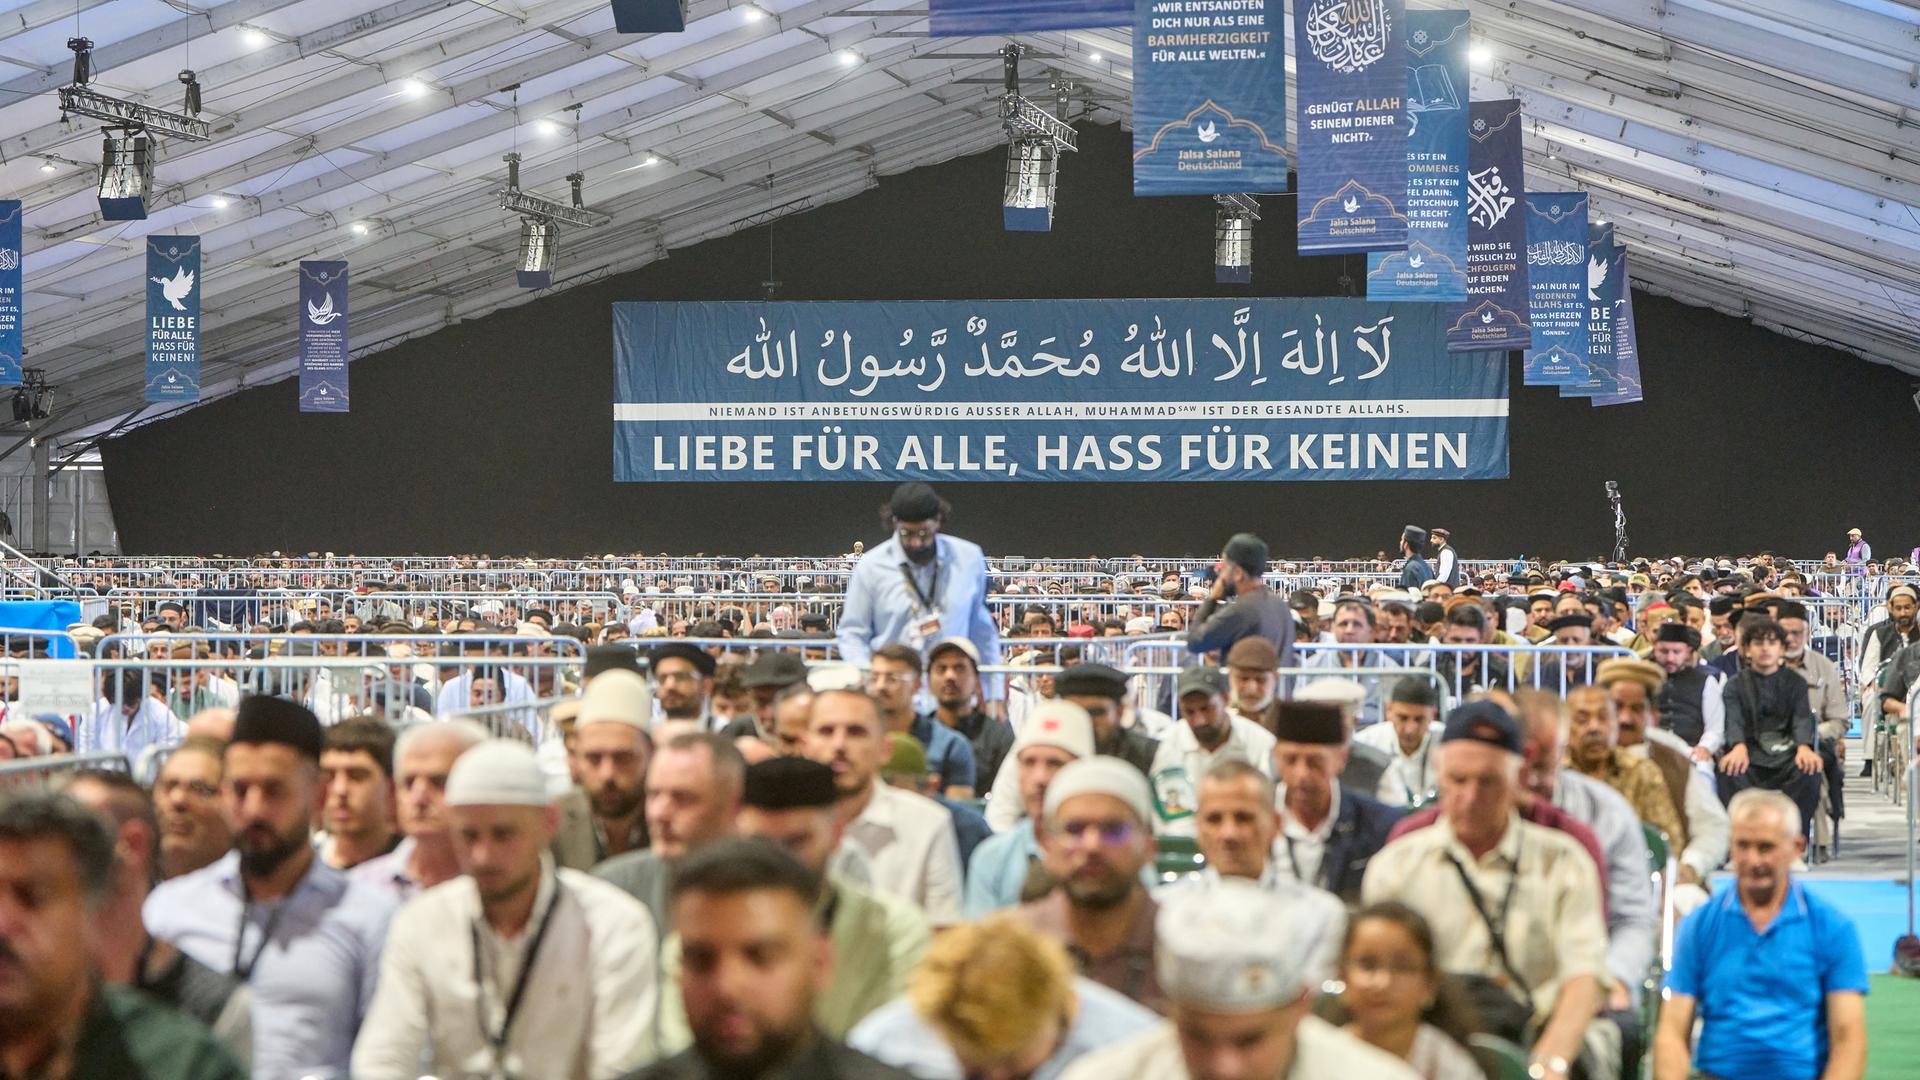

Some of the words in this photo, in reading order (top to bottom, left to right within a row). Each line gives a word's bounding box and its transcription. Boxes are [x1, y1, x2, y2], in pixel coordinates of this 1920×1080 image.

[1185, 0, 1265, 12] ENTSANDTEN
[1152, 18, 1182, 29] DICH
[1184, 17, 1211, 28] NUR
[1213, 16, 1235, 27] ALS
[1237, 15, 1265, 26] EINE
[1147, 32, 1271, 47] BARMHERZIGKEIT
[1152, 49, 1176, 62] FÜR
[1178, 50, 1206, 61] ALLE
[1355, 97, 1400, 112] ALLAH
[1310, 117, 1352, 130] SEINEM
[1354, 115, 1394, 127] DIENER
[1179, 150, 1204, 160] Jalsa
[1206, 148, 1241, 159] Salana
[1417, 153, 1430, 161] IST
[1432, 153, 1447, 161] EIN
[1178, 160, 1242, 171] Deutschland
[1408, 164, 1460, 173] OMMENES
[1413, 178, 1423, 186] ES
[1424, 178, 1437, 186] IST
[1439, 178, 1460, 187] KEIN
[1407, 189, 1421, 197] FEL
[1422, 189, 1453, 197] DARIN:
[1407, 199, 1460, 208] CHTSCHNUR
[1420, 210, 1452, 218] RECHT-
[1472, 243, 1497, 251] WIRD
[1498, 242, 1512, 250] SIE
[1505, 252, 1517, 260] ZU
[1467, 276, 1479, 284] UF
[1481, 274, 1509, 283] ERDEN
[1535, 292, 1577, 300] GEDENKEN
[152, 316, 195, 329] LIEBE
[152, 330, 170, 340] FÜR
[170, 331, 195, 341] ALLE,
[1592, 332, 1611, 343] FÜR
[152, 342, 176, 351] HASS
[177, 340, 195, 351] FÜR
[152, 353, 195, 362] KEINEN!
[709, 406, 778, 417] NIEMAND
[784, 406, 805, 416] IST
[811, 404, 960, 417] ANBETUNGSWÜRDIG
[965, 406, 1021, 416] AUSSER
[1026, 406, 1079, 418] ALLAH,
[1202, 406, 1225, 416] IST
[1231, 405, 1260, 416] DER
[1265, 405, 1343, 416] GESANDTE
[1348, 405, 1410, 415] ALLAHS.
[653, 435, 775, 471] LIEBE
[792, 426, 882, 471] FÜR
[896, 435, 1019, 477] ALLE,
[1037, 434, 1162, 471] HASS
[1180, 425, 1273, 471] FÜR
[1290, 432, 1467, 471] KEINEN
